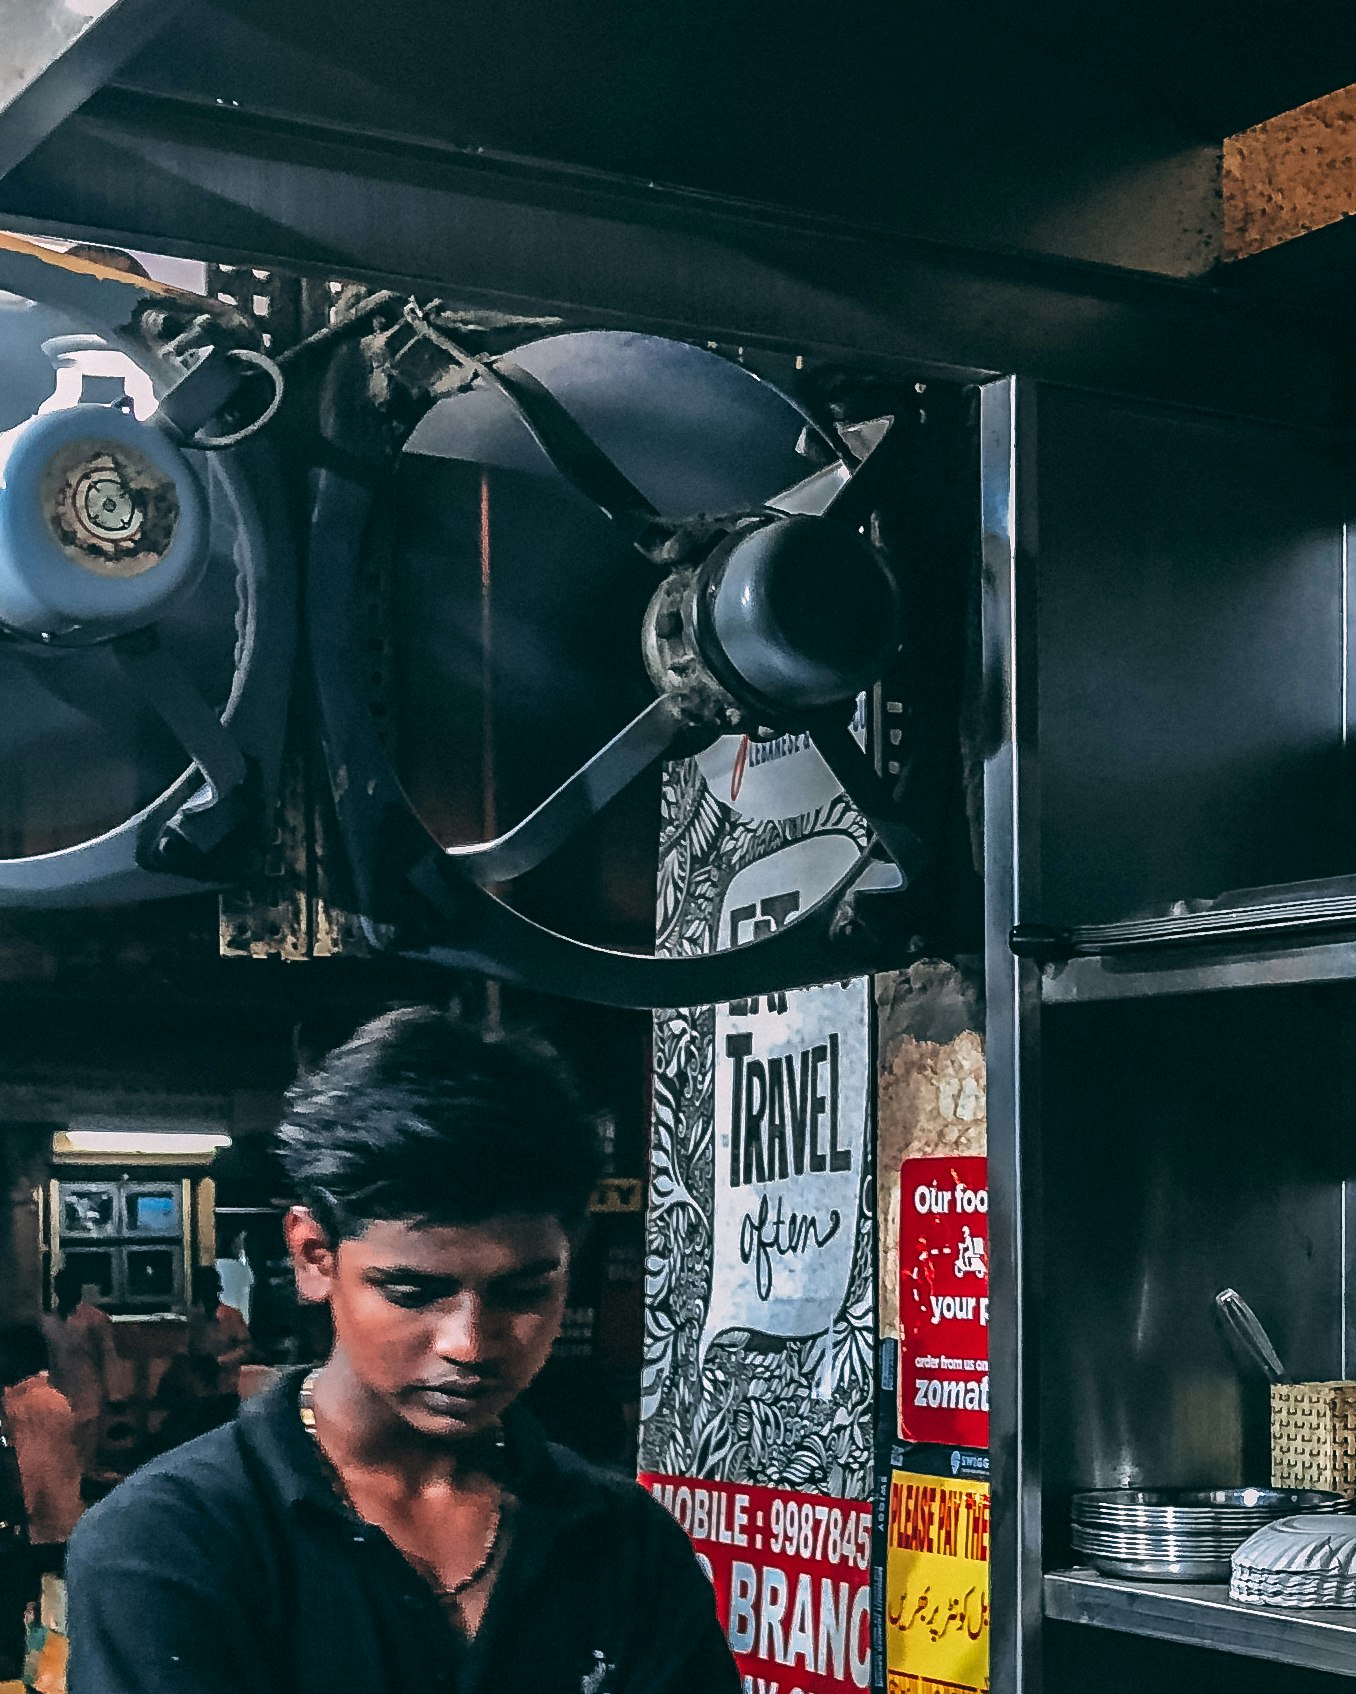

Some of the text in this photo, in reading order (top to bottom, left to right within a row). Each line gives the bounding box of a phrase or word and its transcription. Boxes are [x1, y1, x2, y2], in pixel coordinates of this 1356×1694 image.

[726, 1032, 852, 1188] TRAVEL
[914, 1184, 951, 1215] Our
[740, 1193, 841, 1301] often
[929, 1295, 977, 1325] your
[914, 1354, 940, 1369] order
[940, 1354, 963, 1371] from
[963, 1359, 976, 1371] us
[770, 1499, 873, 1571] 9987845
[890, 1483, 937, 1554] PLEASE
[937, 1488, 963, 1557] PAY
